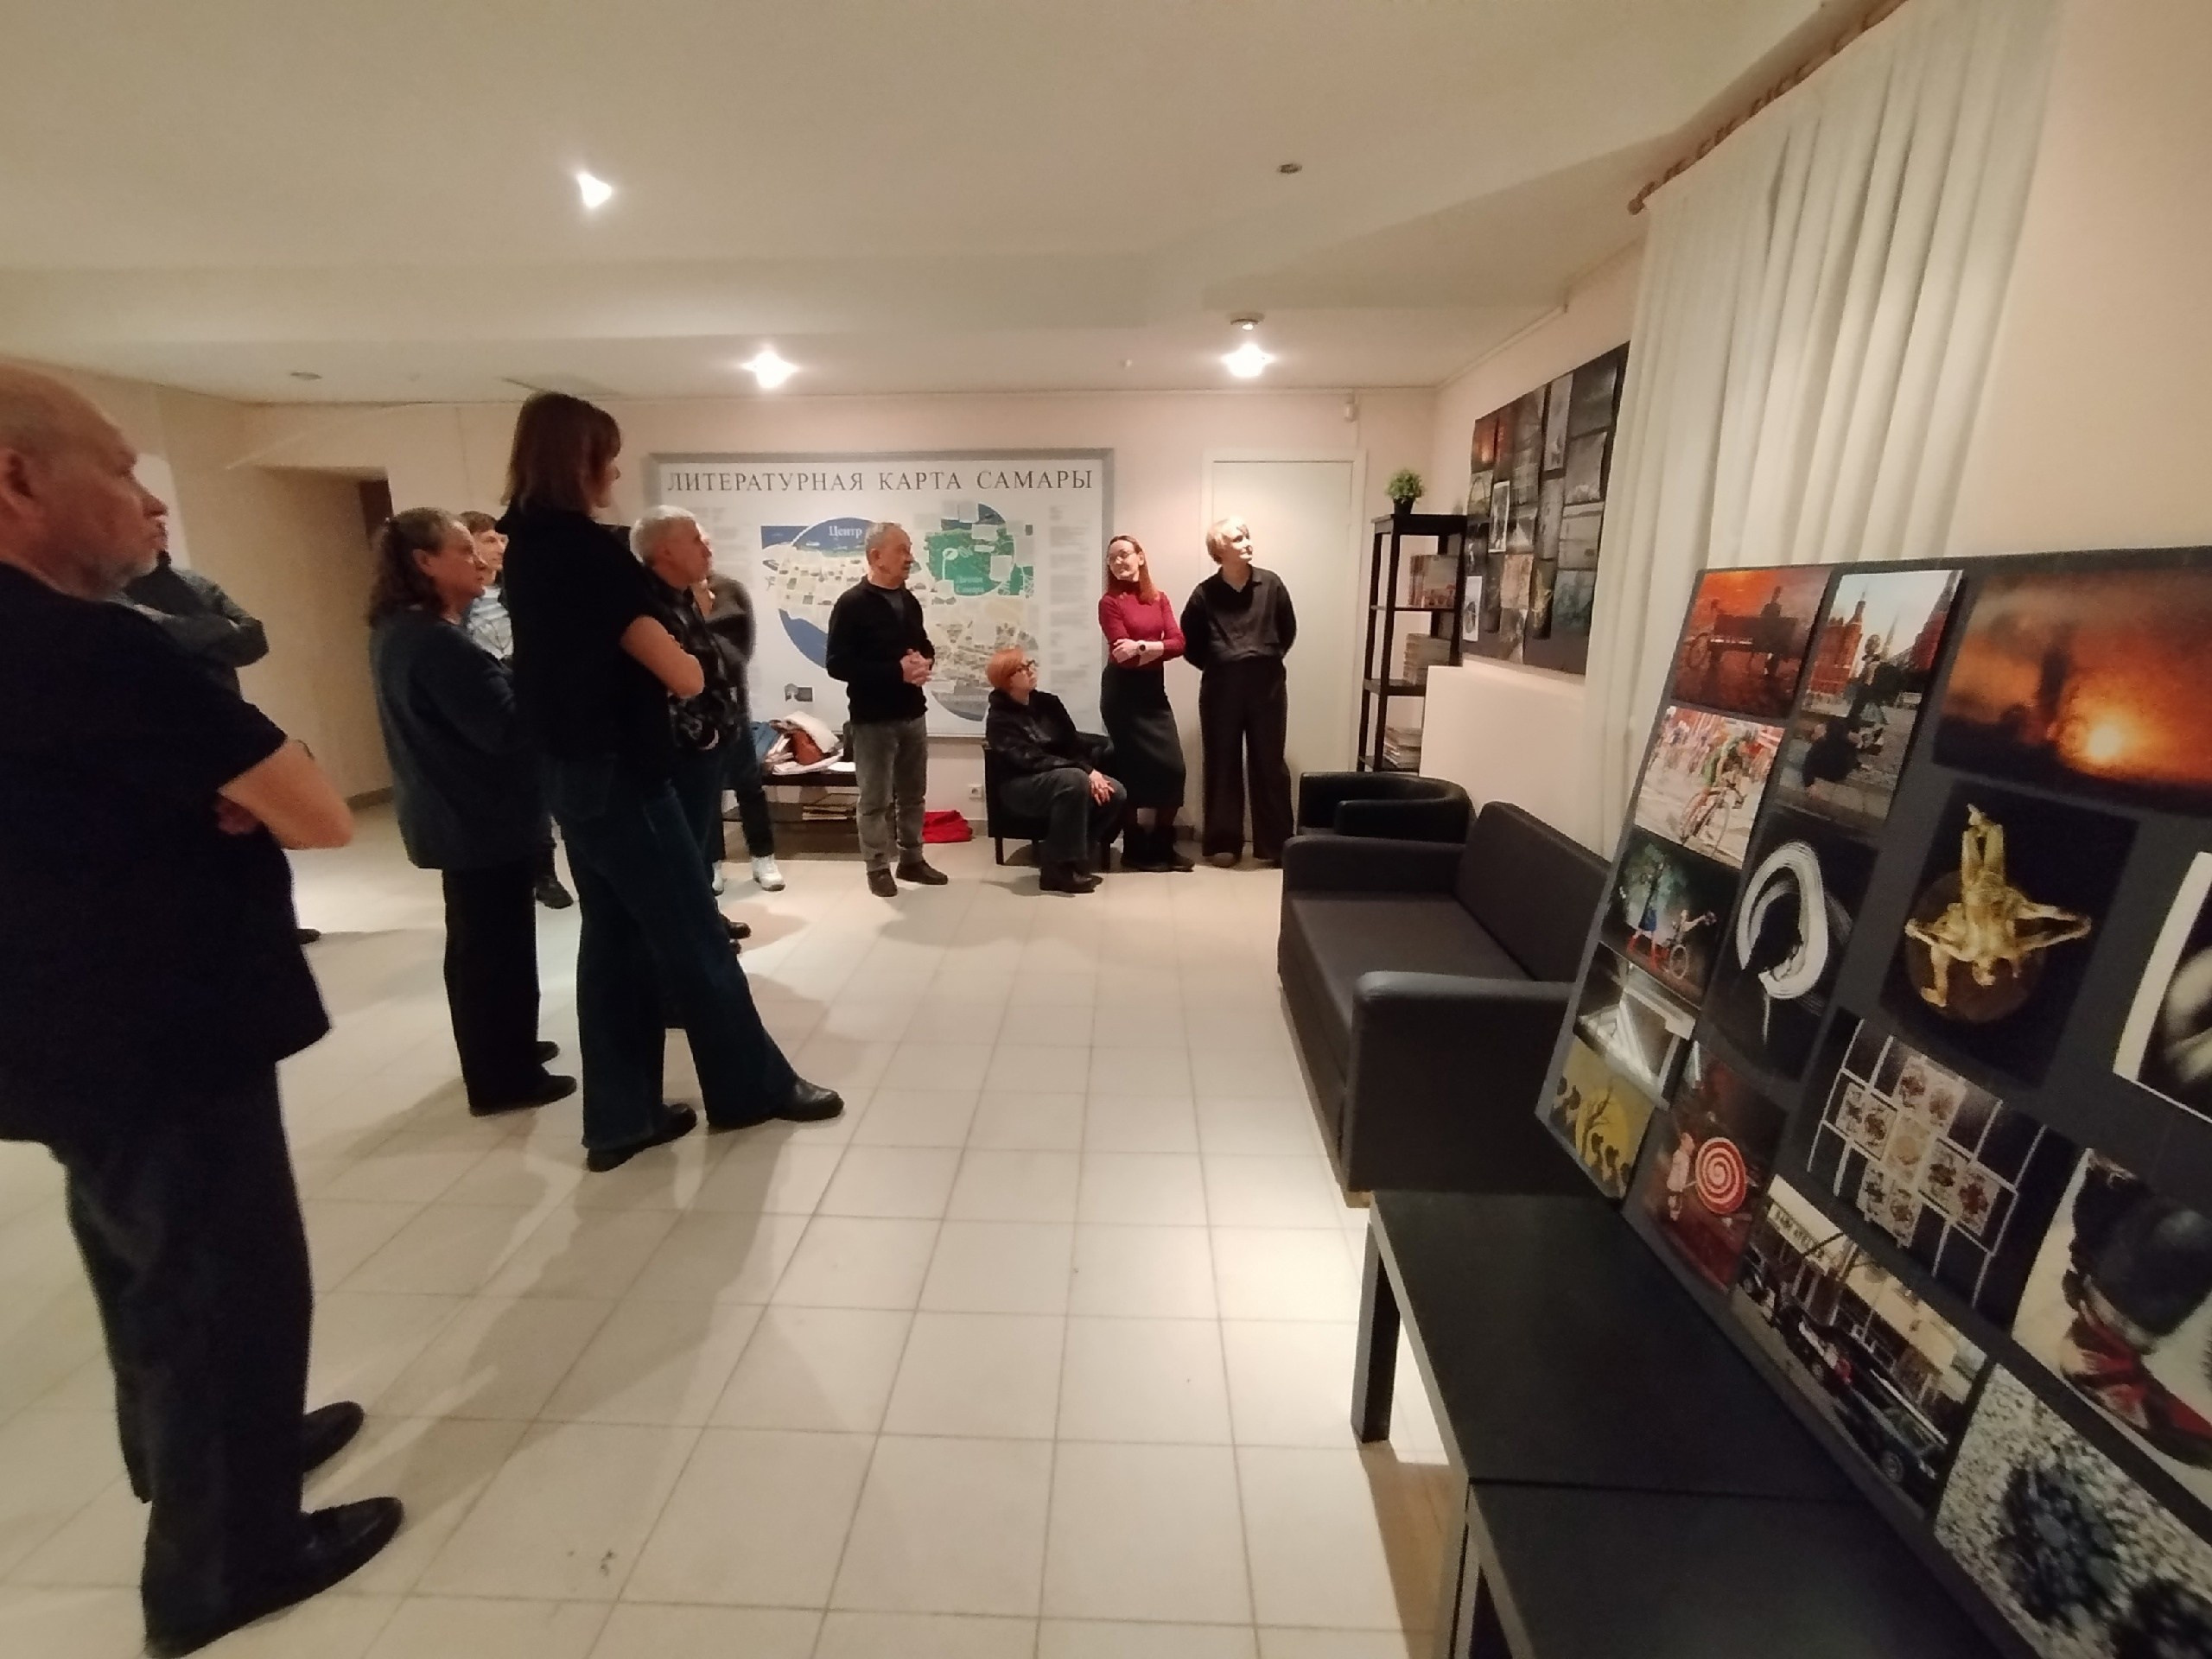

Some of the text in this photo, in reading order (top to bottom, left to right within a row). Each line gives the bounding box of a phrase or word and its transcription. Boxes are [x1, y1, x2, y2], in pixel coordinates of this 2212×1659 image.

[667, 469, 1093, 492] ЛИТЕРАТУРНАЯ КАРТА САМАРЫ
[829, 524, 863, 539] Центр
